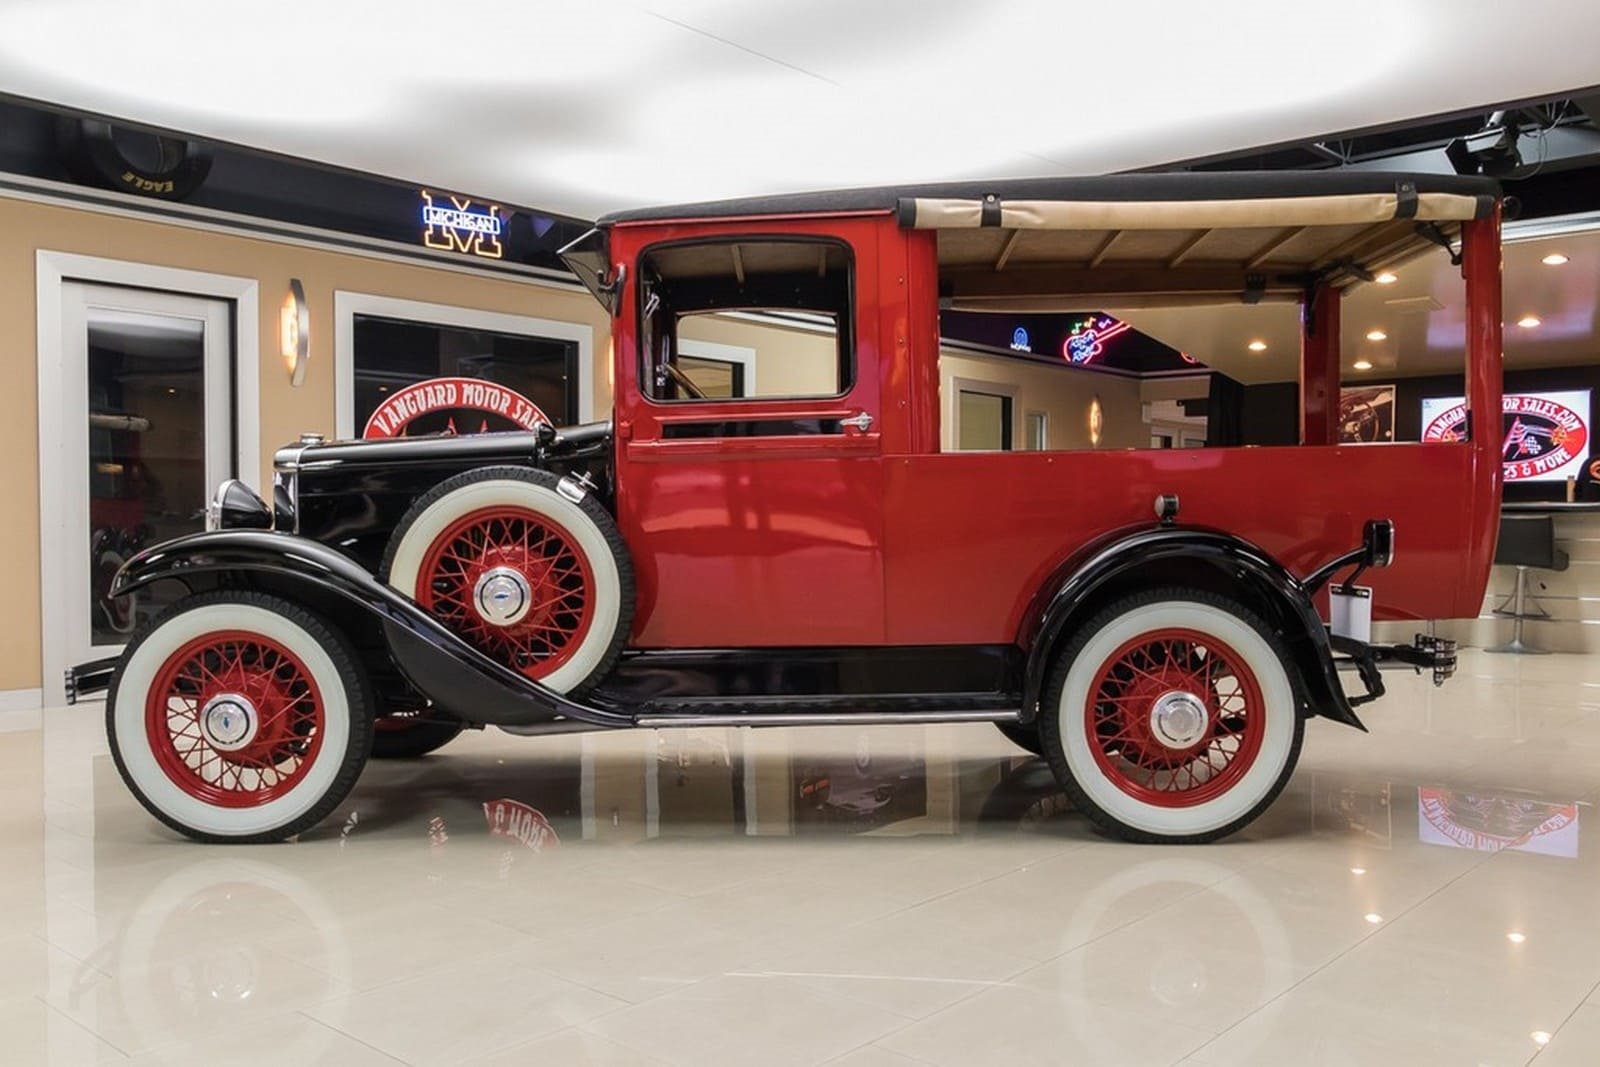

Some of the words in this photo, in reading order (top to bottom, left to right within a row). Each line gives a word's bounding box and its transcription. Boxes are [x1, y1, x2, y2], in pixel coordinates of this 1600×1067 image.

[121, 172, 173, 192] EAGLE
[429, 209, 495, 233] MICHIGAN
[374, 383, 457, 436] VANGUARD
[462, 383, 511, 414] MOTOR
[512, 399, 547, 430] SAL
[1427, 405, 1466, 438] VANGUA
[1521, 399, 1581, 432] SALES.COM
[1534, 448, 1571, 473] MORE
